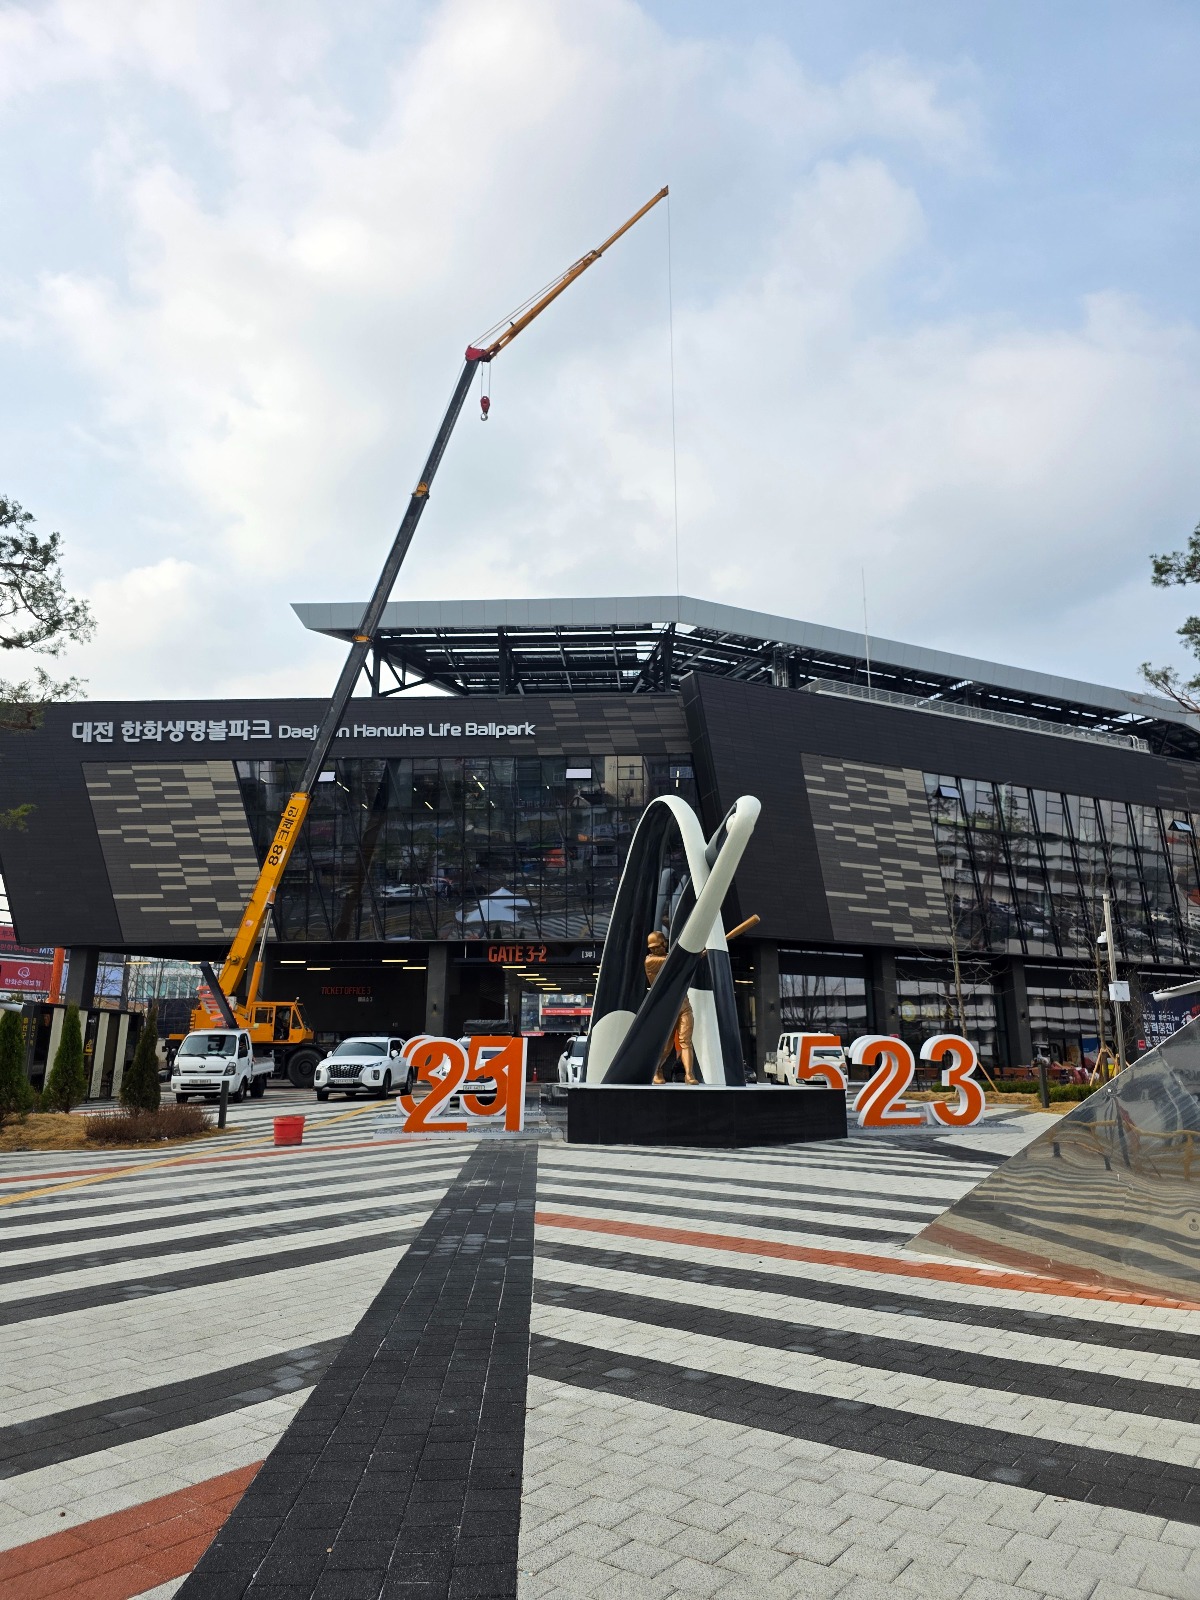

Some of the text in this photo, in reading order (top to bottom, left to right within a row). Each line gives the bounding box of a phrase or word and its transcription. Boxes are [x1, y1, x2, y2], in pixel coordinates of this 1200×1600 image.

[71, 719, 273, 743] 대전 한화생명볼파크
[278, 721, 536, 741] Daejn Hanwha Life Ballpark
[488, 945, 547, 962] GATE 3-2
[321, 986, 344, 995] TICKET
[345, 986, 366, 995] OFFICE
